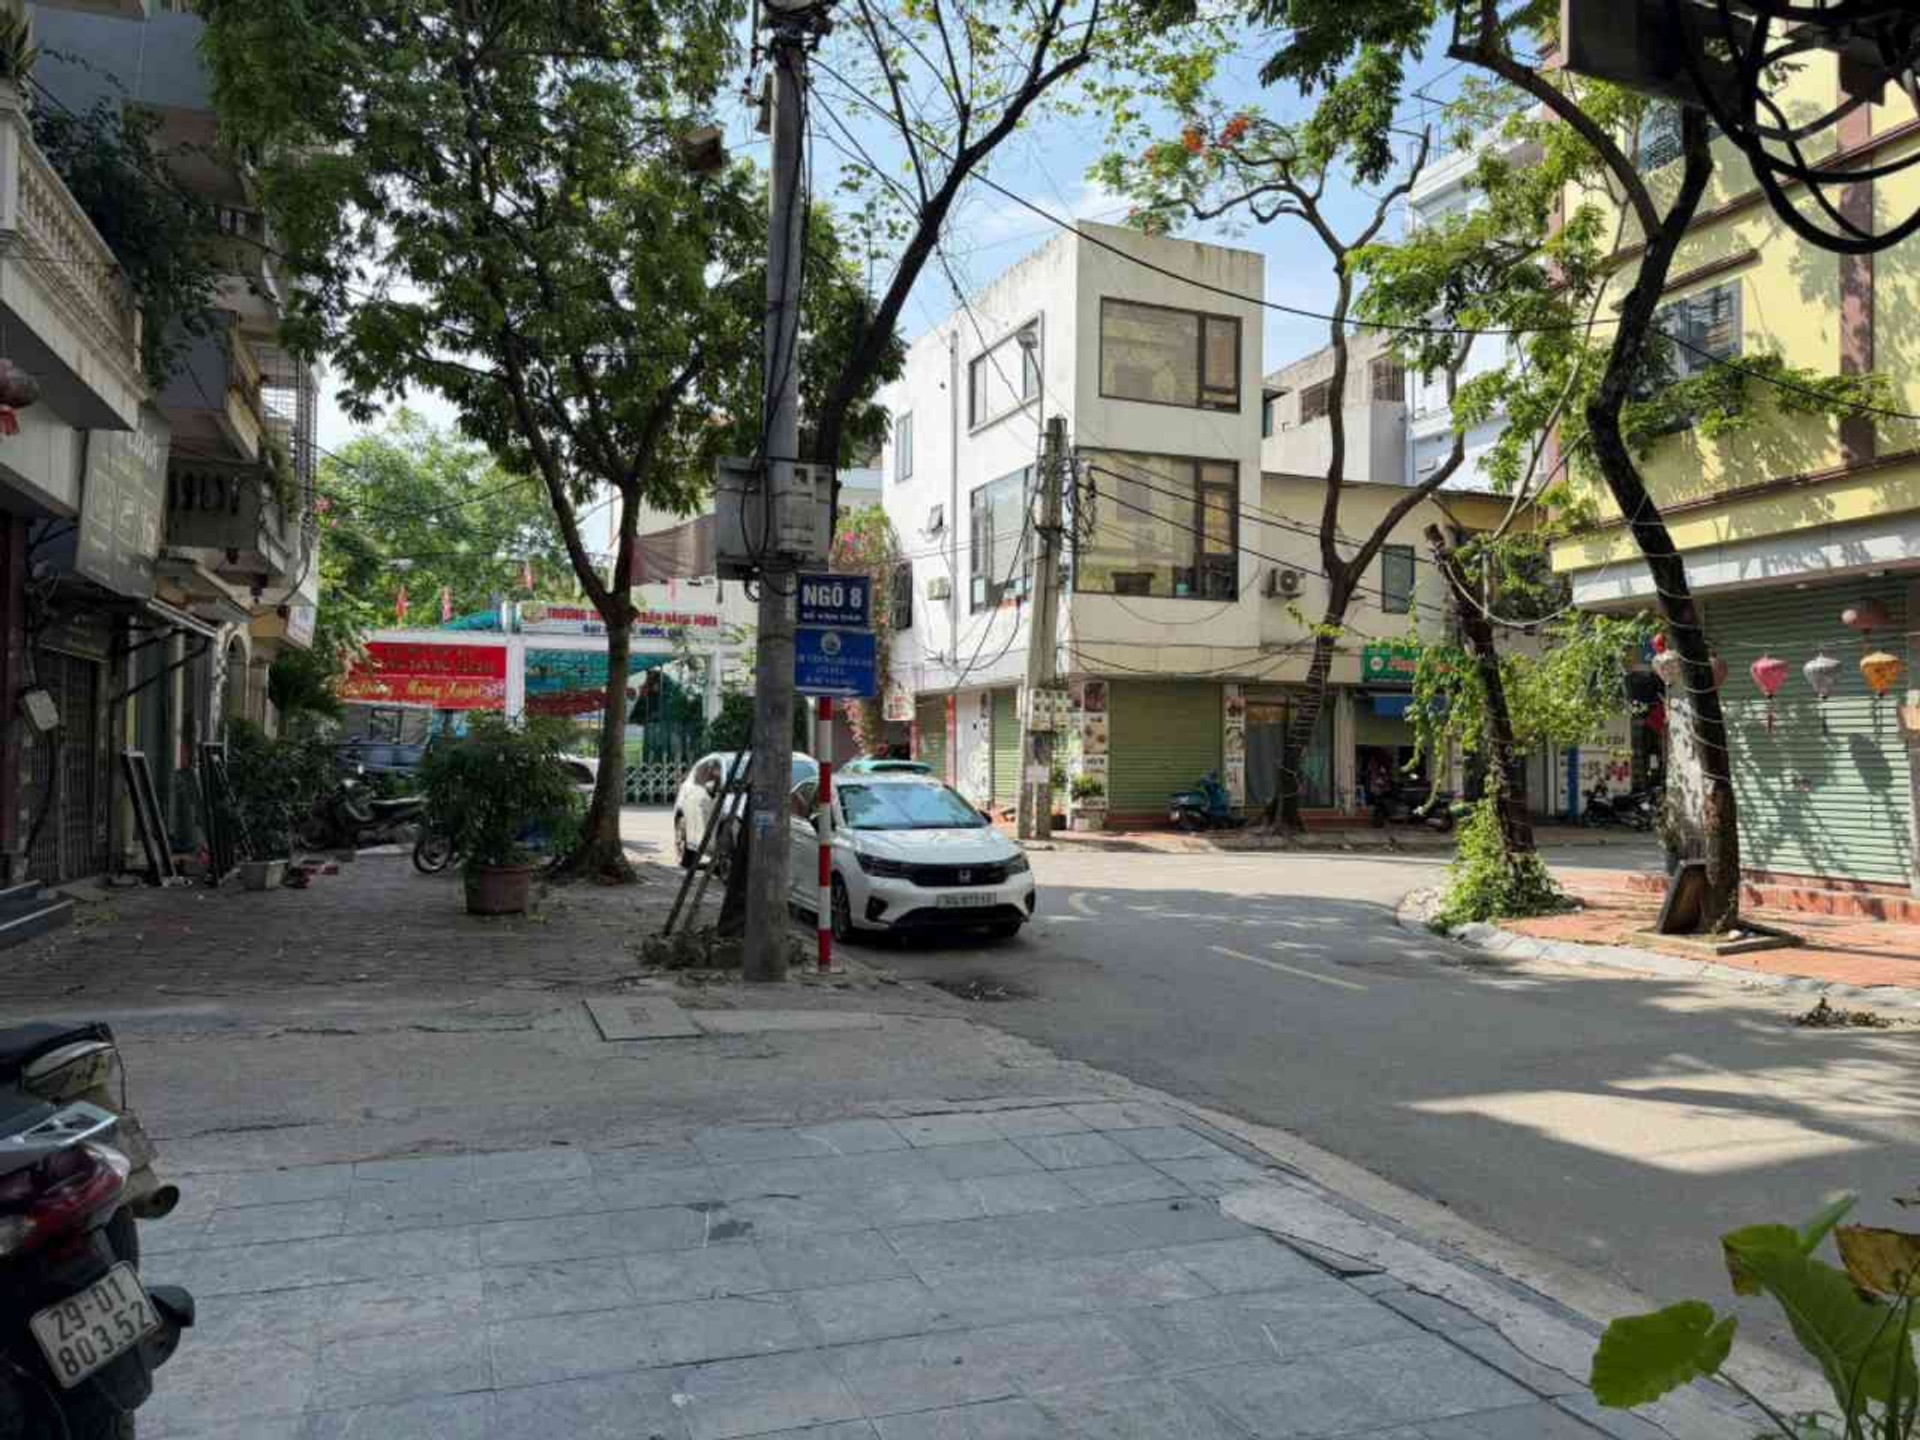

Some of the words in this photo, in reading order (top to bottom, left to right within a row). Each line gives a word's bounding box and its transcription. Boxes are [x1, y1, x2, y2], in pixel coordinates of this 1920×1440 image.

[803, 582, 843, 607] NGÕ
[851, 588, 862, 608] 8
[58, 1300, 151, 1376] 803.52
